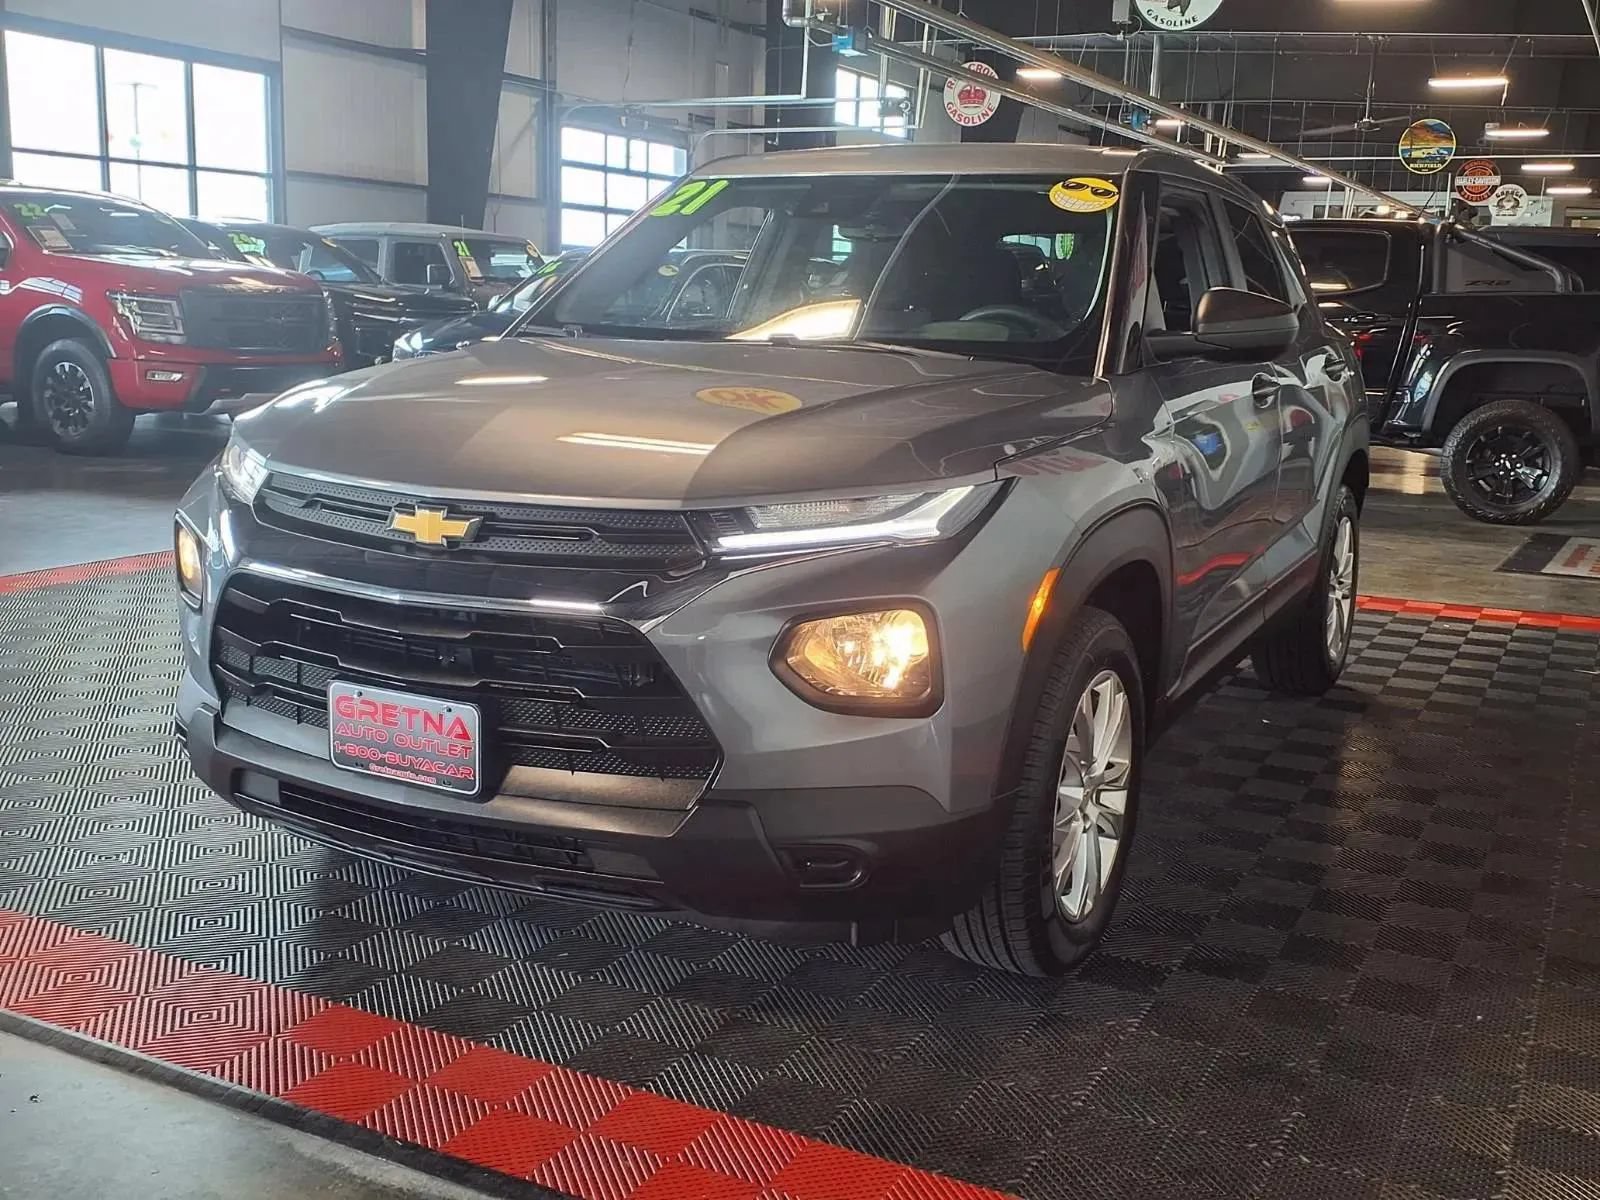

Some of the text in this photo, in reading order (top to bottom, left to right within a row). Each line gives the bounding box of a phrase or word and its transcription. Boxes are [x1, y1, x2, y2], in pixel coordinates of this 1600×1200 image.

[1146, 9, 1198, 27] GASOLINE
[968, 63, 997, 78] CRO
[946, 101, 995, 125] GASOLINE
[13, 204, 49, 216] 22
[650, 180, 730, 216] 21
[335, 695, 472, 742] GRETNA
[335, 723, 472, 760] AUTO OUTLET
[334, 741, 474, 781] 1-800-BUYACAR
